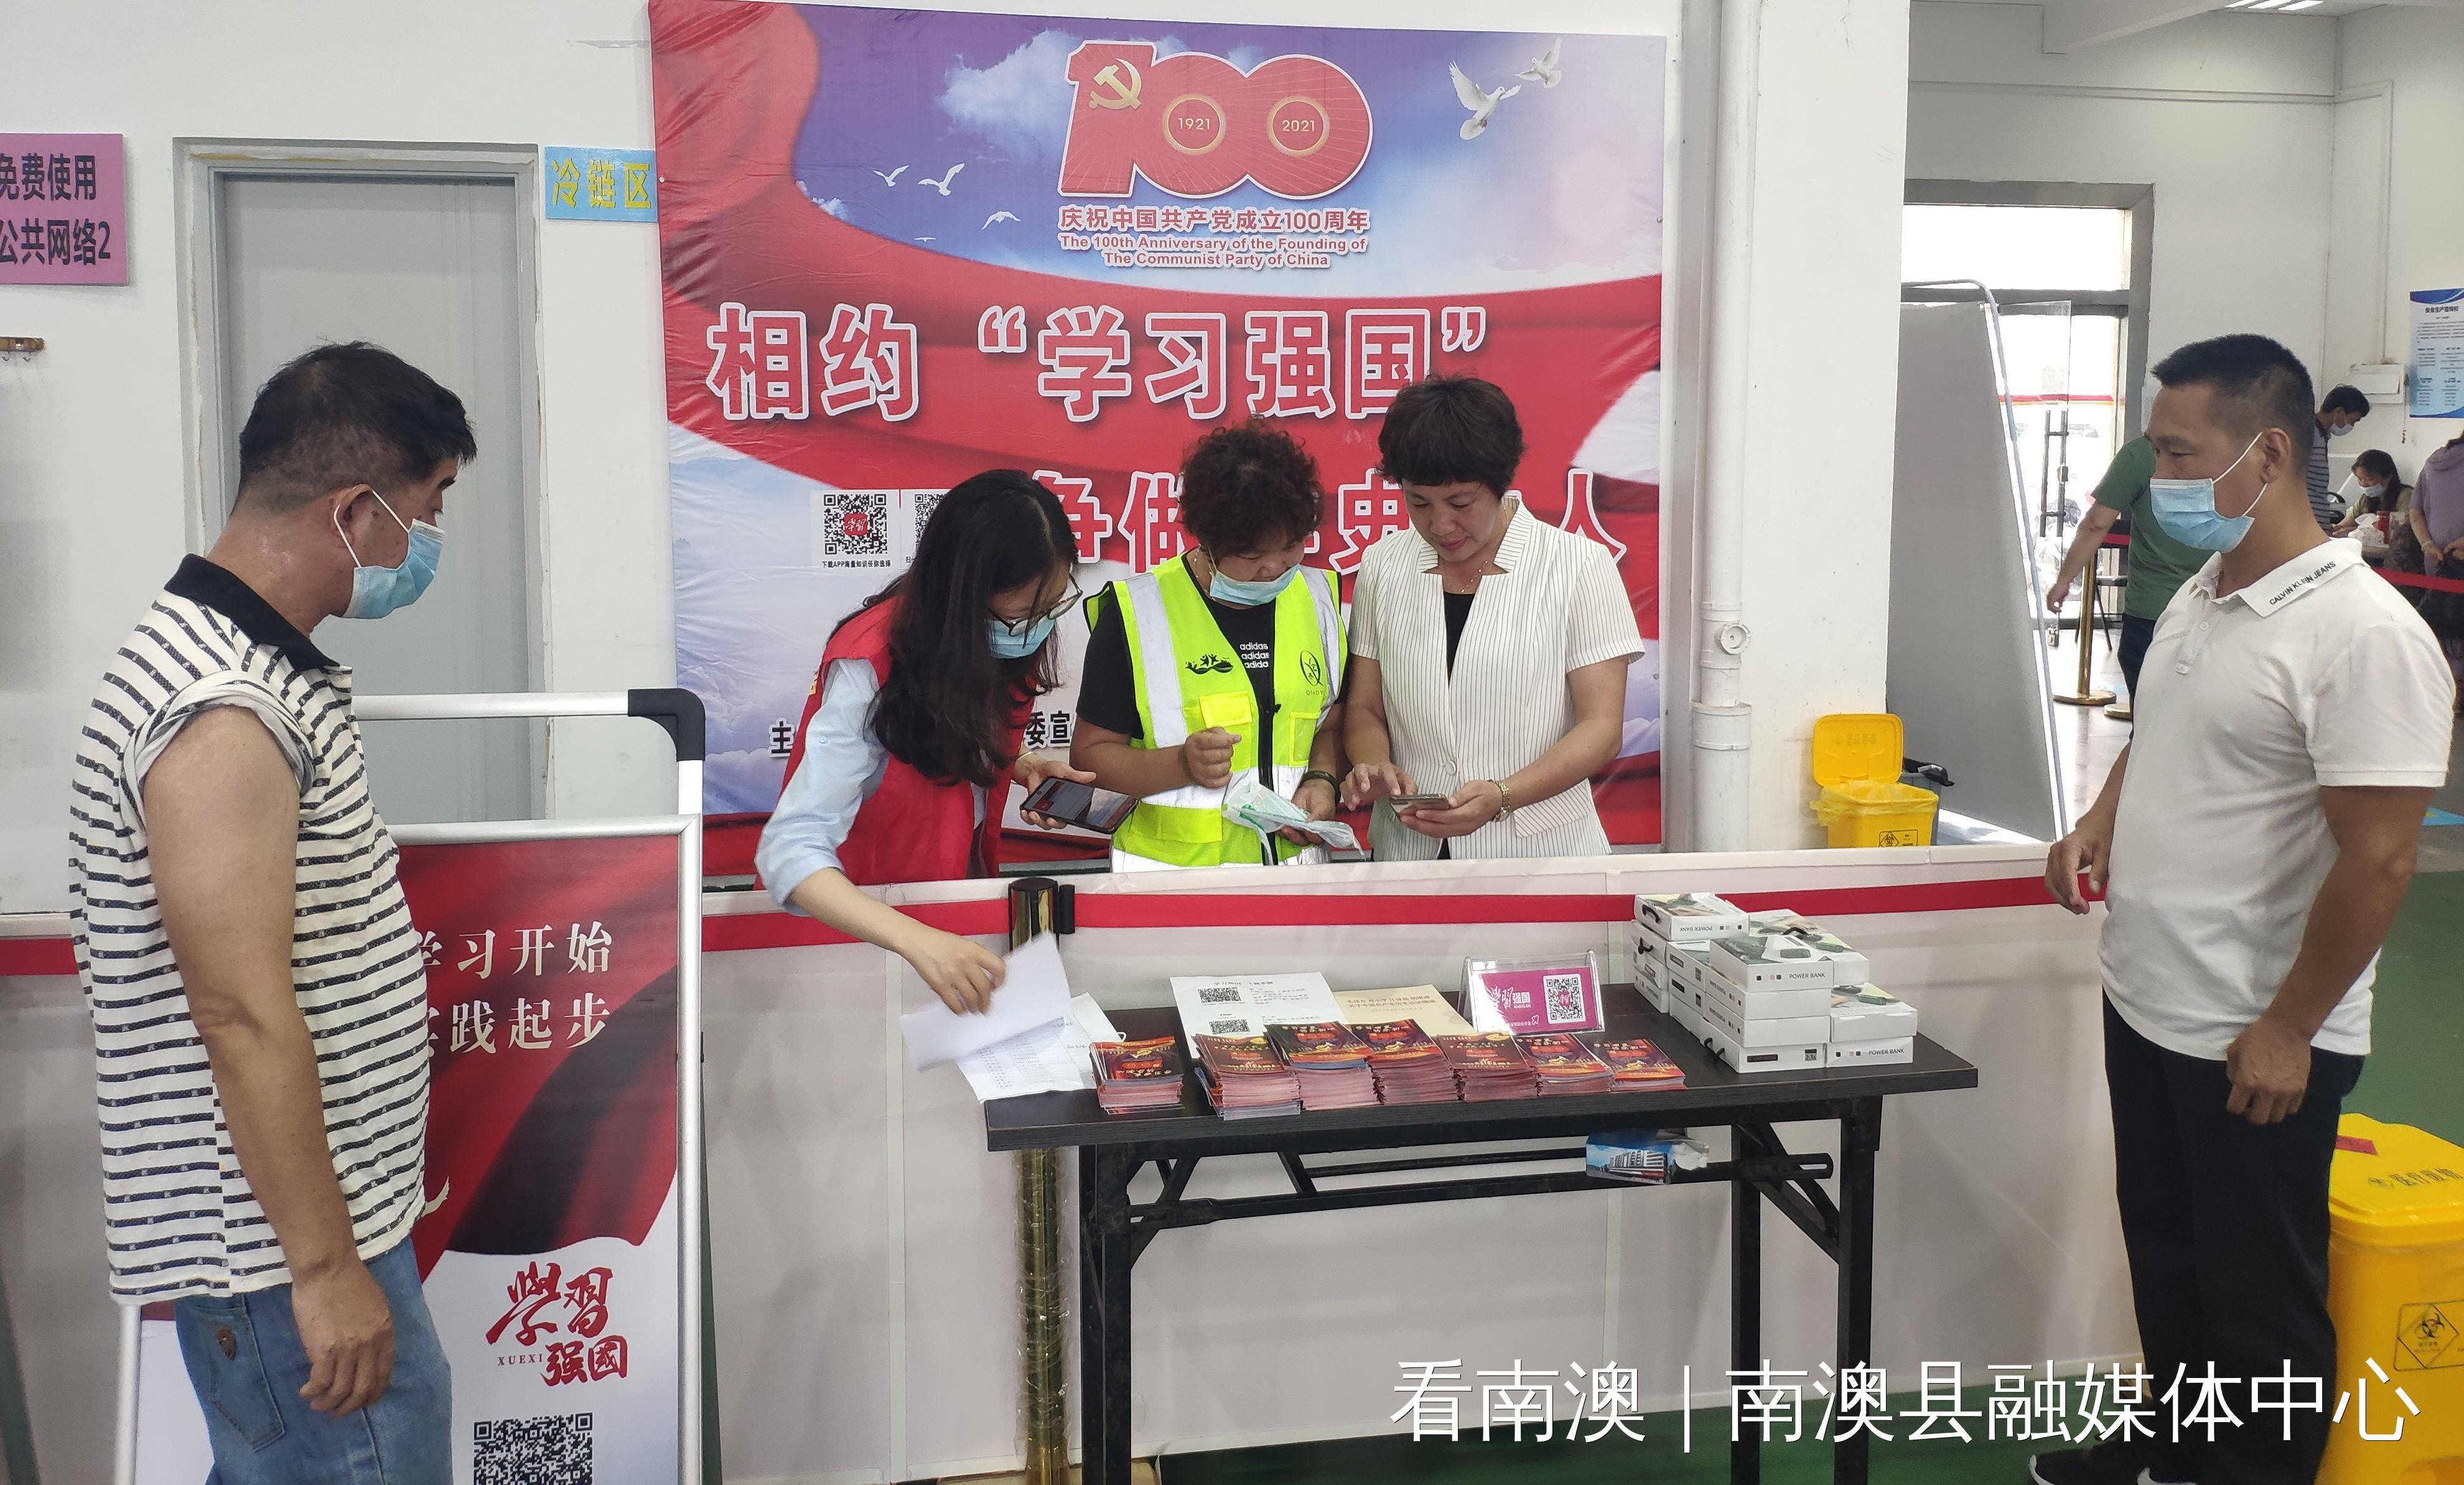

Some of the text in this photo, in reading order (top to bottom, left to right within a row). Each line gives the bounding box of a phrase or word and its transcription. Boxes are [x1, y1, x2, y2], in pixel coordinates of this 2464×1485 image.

[1177, 118, 1211, 131] 1921
[1281, 119, 1315, 133] 2021
[0, 153, 96, 200] 免费使用
[552, 157, 651, 208] 冷链区
[1060, 207, 1368, 231] 庆祝中国共产党成立100周年
[0, 218, 111, 266] 公共网络2
[1060, 235, 1366, 252] The 100th Anniversary of the Founding of
[1104, 252, 1328, 268] The Communist Party of China
[706, 302, 919, 421] 相约
[2269, 561, 2336, 605] CALVIN KLEIN JEANS
[1239, 642, 1269, 651] adidas
[1244, 661, 1269, 669] adida
[498, 1352, 543, 1366] XUEXI
